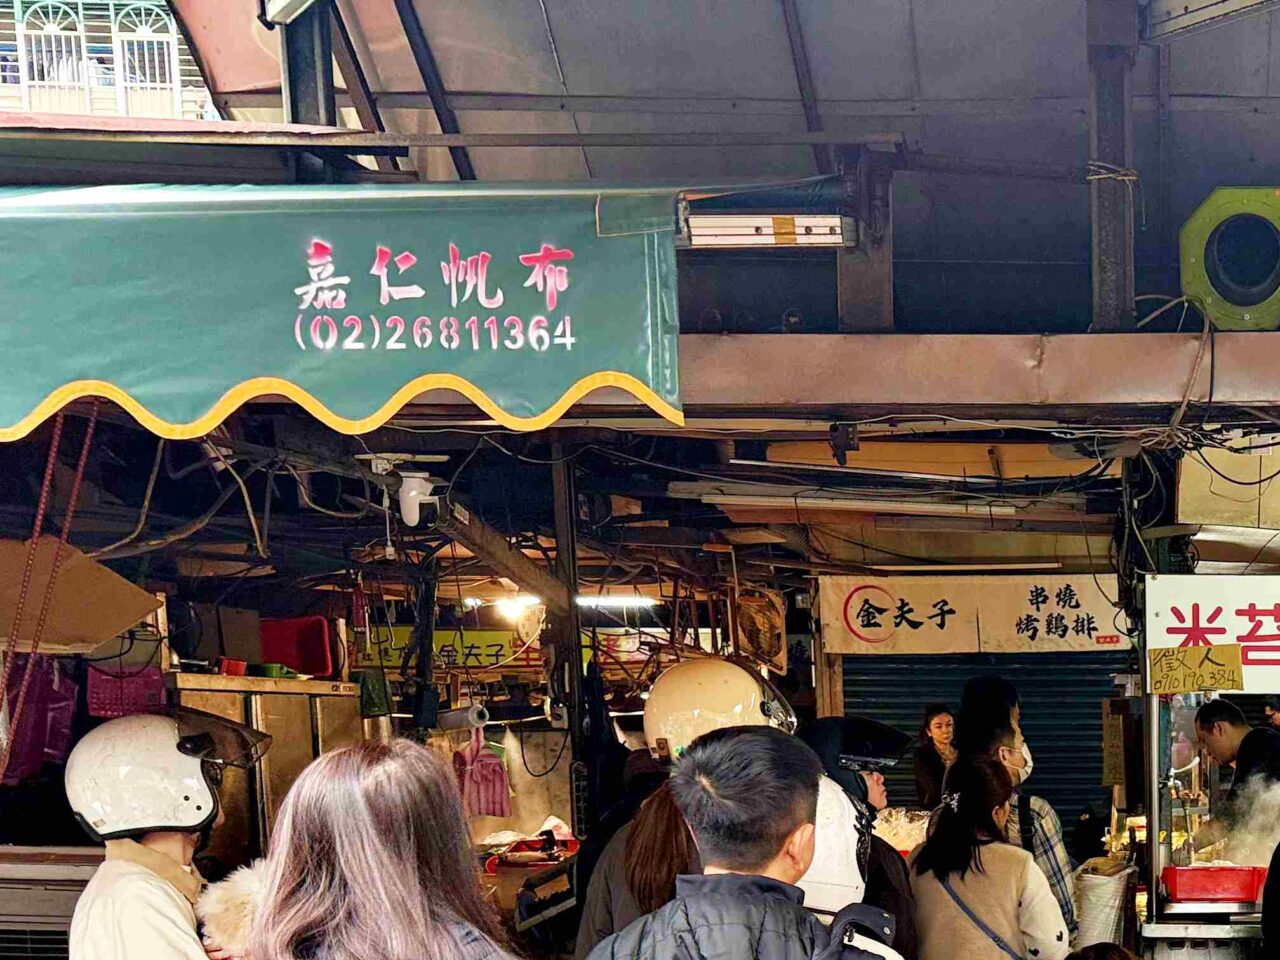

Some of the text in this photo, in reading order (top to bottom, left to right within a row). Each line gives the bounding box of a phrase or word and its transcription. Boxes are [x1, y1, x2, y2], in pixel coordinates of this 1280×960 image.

[294, 239, 575, 311] 嘉仁帆布
[294, 314, 577, 351] (02)26811364
[1028, 583, 1081, 612] 串燒
[856, 598, 957, 630] 金夫子
[439, 643, 506, 667] 金夫子
[1153, 648, 1226, 672] 徵人
